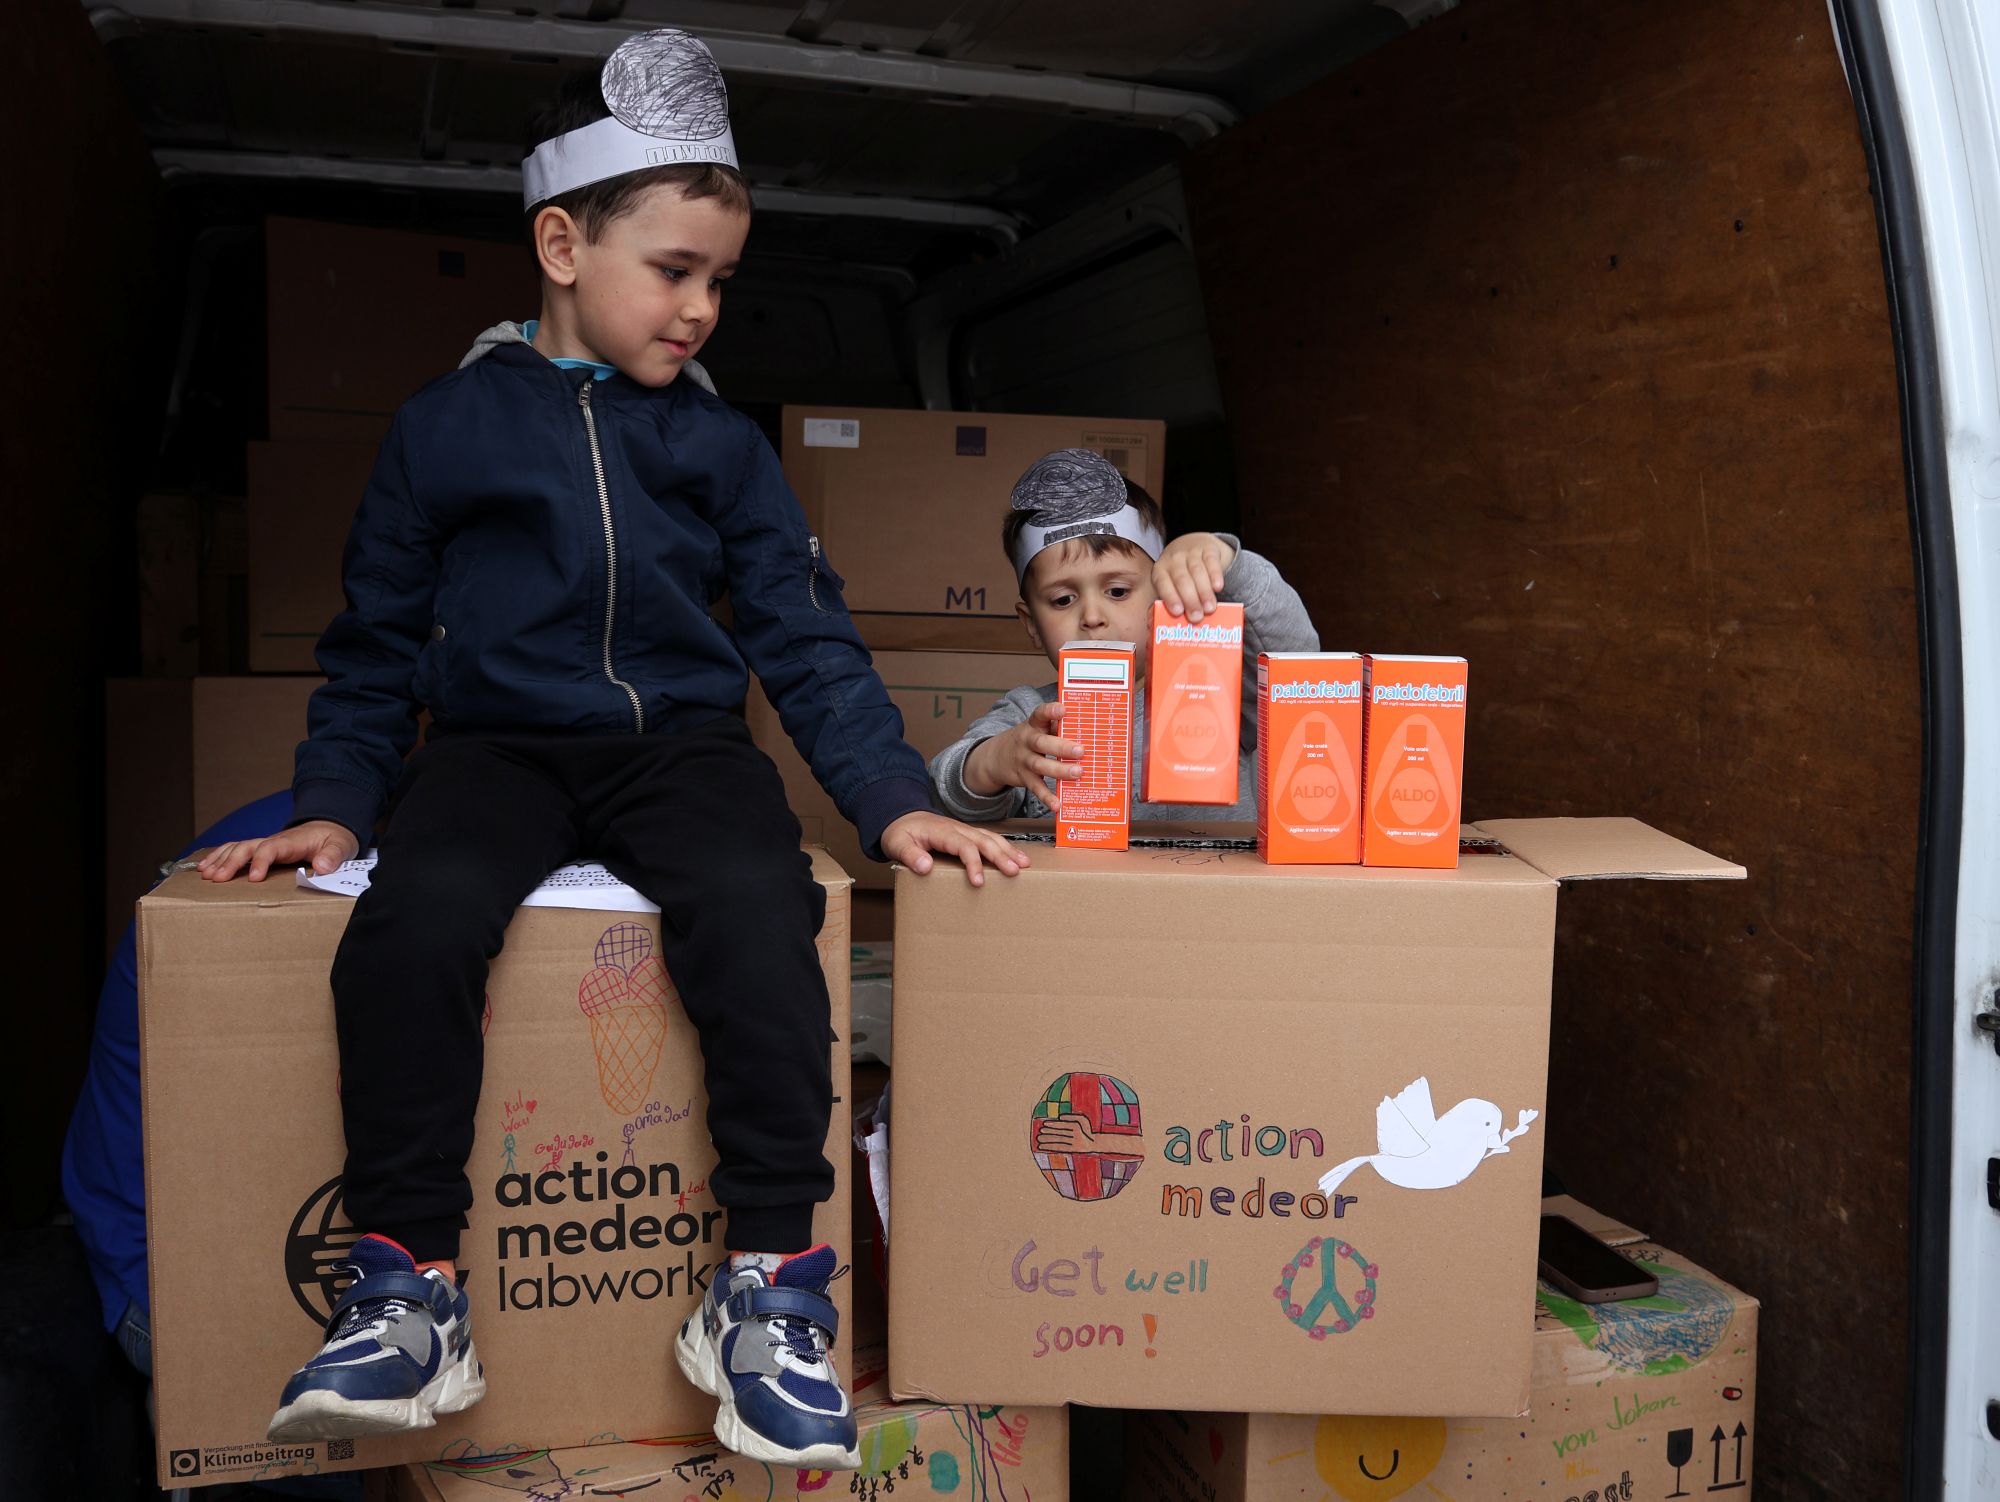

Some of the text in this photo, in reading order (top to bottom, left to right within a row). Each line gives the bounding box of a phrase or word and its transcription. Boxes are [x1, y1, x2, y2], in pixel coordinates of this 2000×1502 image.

[945, 586, 987, 611] M1
[1156, 624, 1242, 644] paidofebril
[1271, 680, 1361, 701] paidofebril
[1374, 683, 1464, 703] paidofebril
[933, 695, 962, 719] L1
[1174, 725, 1217, 737] ALDO
[1293, 786, 1337, 799] ALDO
[1392, 789, 1436, 802] ALDO
[1164, 1114, 1324, 1166] action
[495, 1150, 680, 1207] action
[1161, 1177, 1358, 1219] medeor
[497, 1204, 722, 1260] medeor
[499, 1250, 719, 1312] labwork
[1011, 1239, 1208, 1298] Get well
[1033, 1320, 1124, 1358] soon
[1552, 1428, 1599, 1459] von
[204, 1447, 315, 1468] Klimabeitrag
